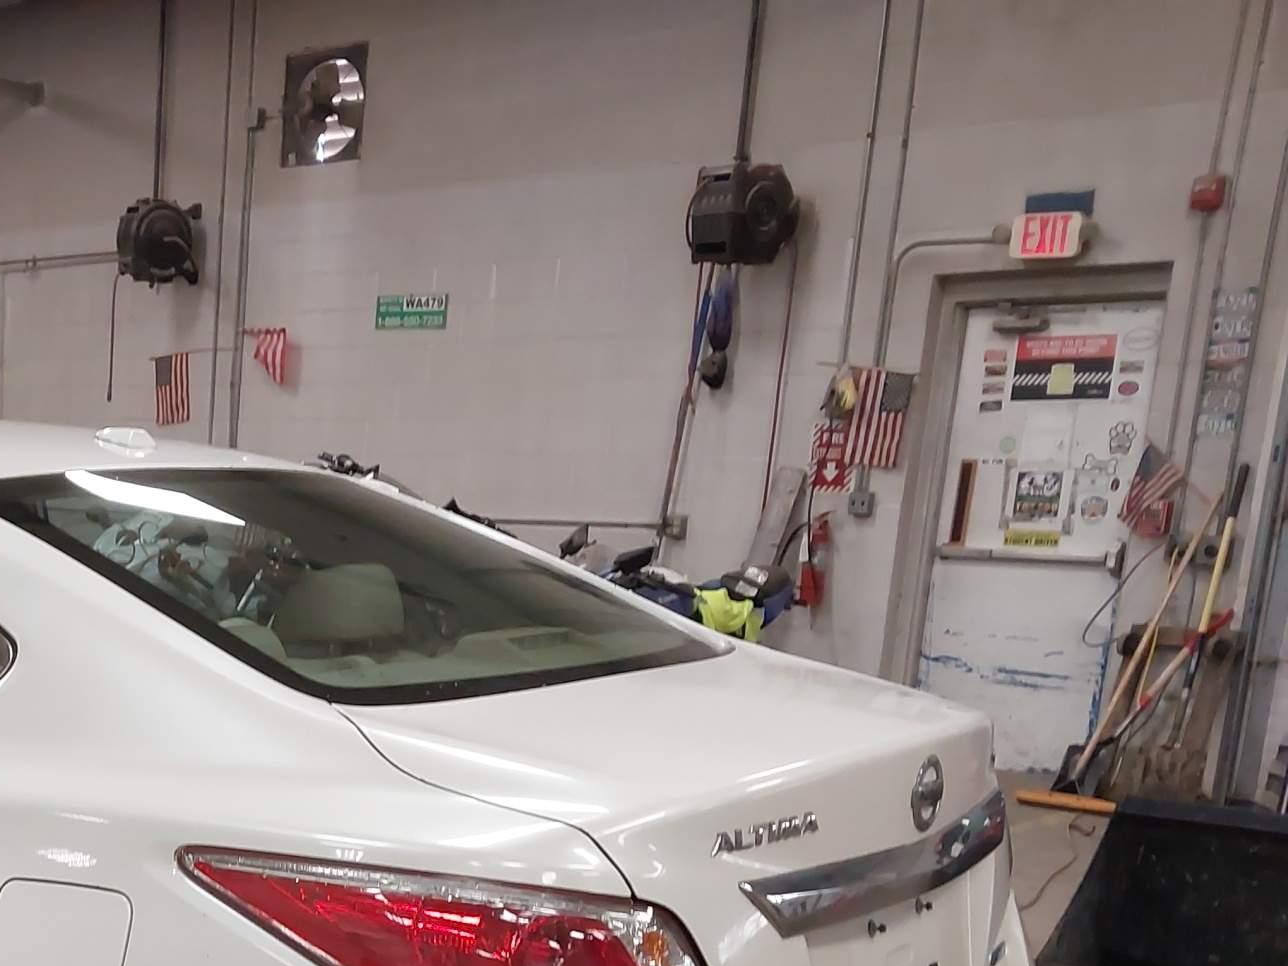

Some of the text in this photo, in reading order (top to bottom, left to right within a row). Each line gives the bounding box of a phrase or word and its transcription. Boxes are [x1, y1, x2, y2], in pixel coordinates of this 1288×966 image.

[1021, 214, 1073, 255] EXIT
[822, 431, 845, 445] FRE
[711, 811, 819, 858] ALTIMA
